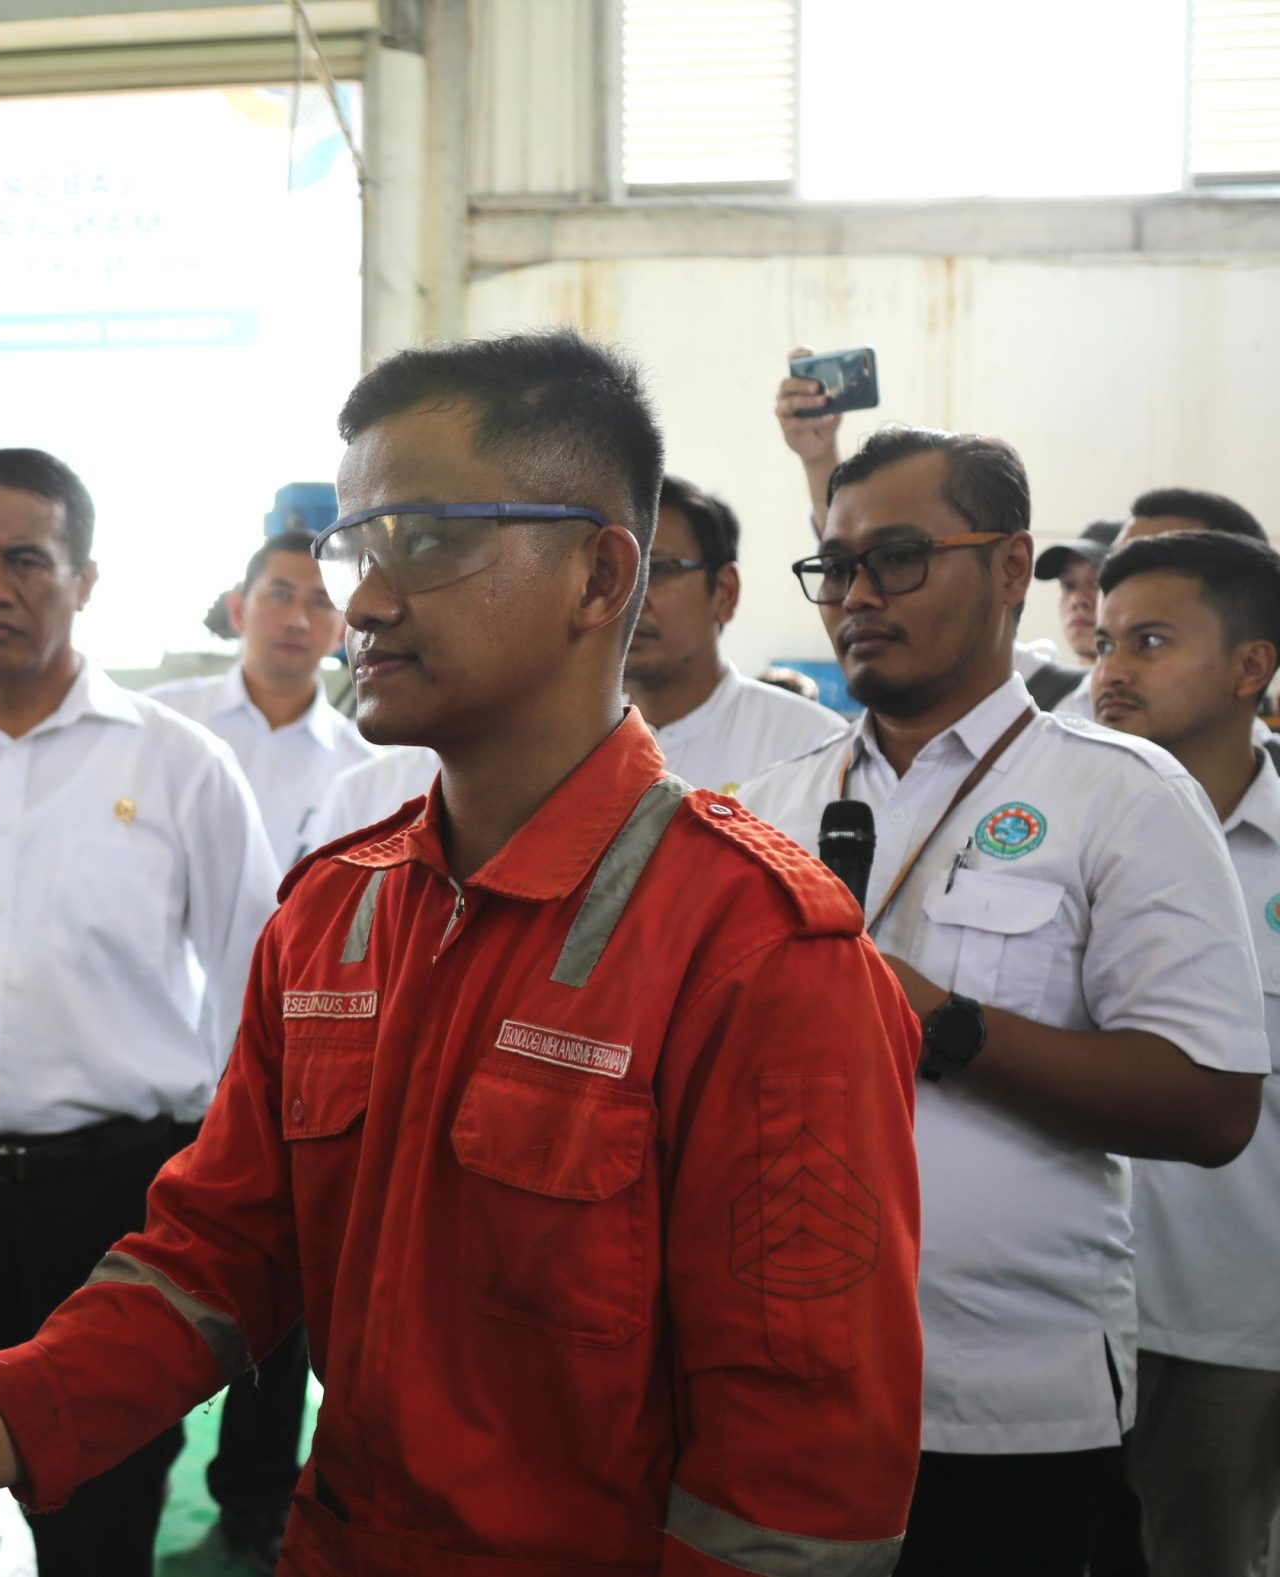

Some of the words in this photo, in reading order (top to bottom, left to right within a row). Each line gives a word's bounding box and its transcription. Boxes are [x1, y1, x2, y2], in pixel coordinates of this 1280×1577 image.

[348, 996, 372, 1013] S.M
[502, 1025, 543, 1052] TEKNOLOGI
[541, 1035, 593, 1064] MEKANISME
[590, 1046, 627, 1073] PERTANIAN
